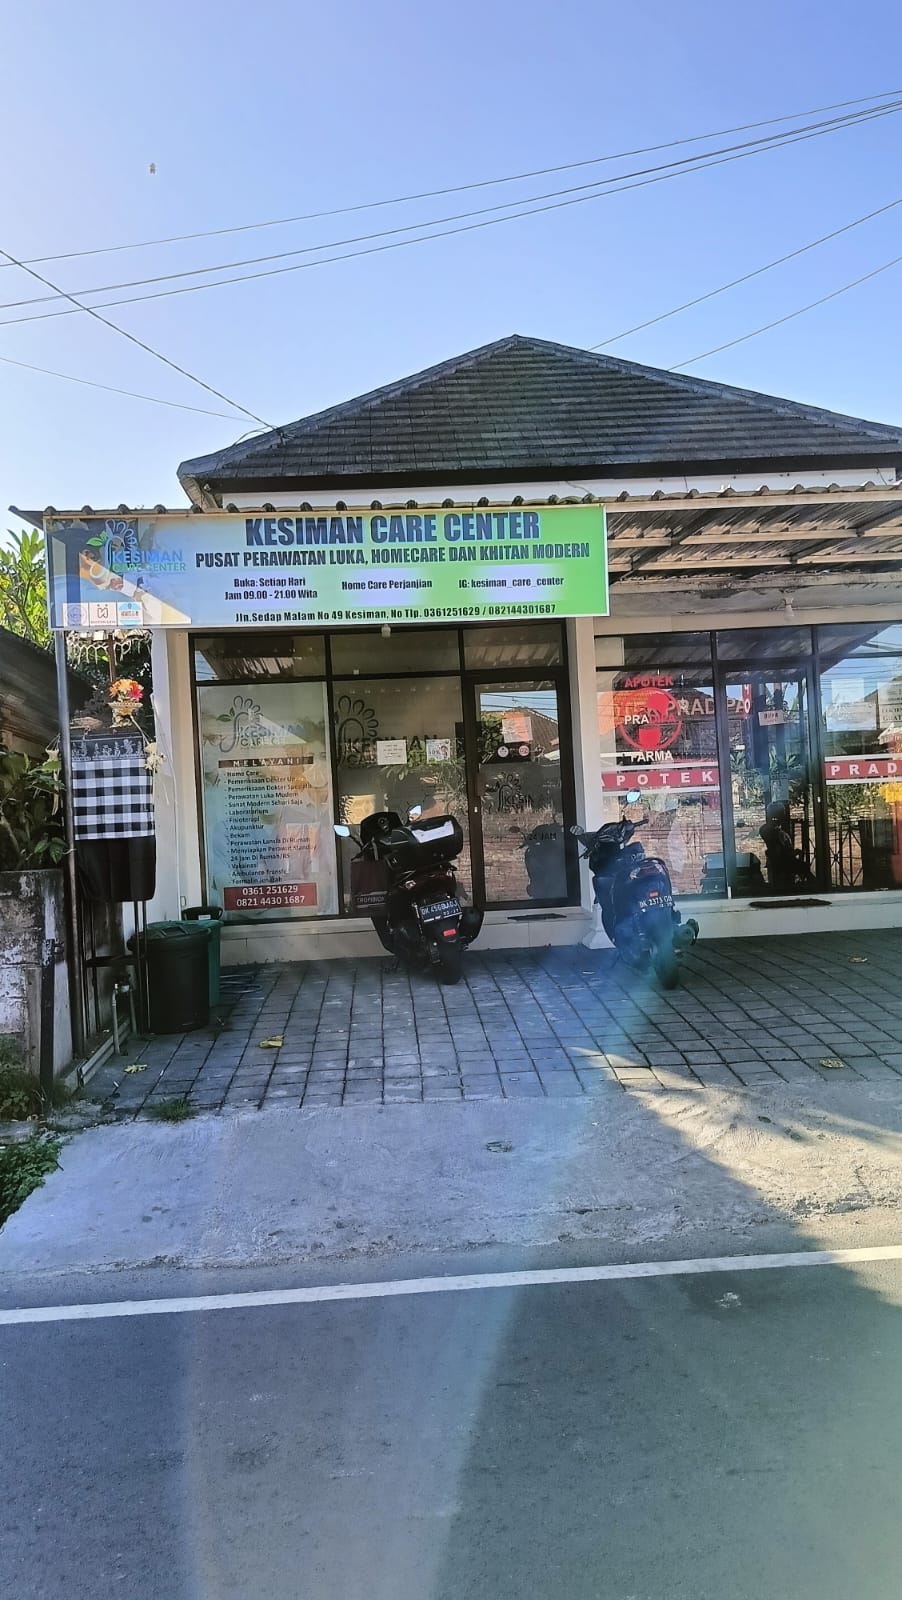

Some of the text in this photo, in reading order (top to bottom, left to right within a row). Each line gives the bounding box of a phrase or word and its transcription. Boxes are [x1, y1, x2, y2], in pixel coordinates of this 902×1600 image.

[245, 512, 540, 546] KESIMAN CARE CENTER
[112, 550, 183, 563] KESIMAN
[195, 543, 590, 568] PUSAT PERAWATAN LUKA, HOMECARE DAN KHITAN MODERN
[112, 562, 187, 573] CARE CENTER
[234, 577, 306, 588] Buka: Setiap Hari
[342, 580, 433, 591] Home Care Perjanjian
[459, 577, 565, 589] IG: kesiman_care_center
[225, 591, 242, 600] Jam
[243, 591, 268, 600] 09.00
[274, 590, 297, 599] 21.00
[298, 589, 318, 599] Wita
[284, 611, 315, 621] Malam
[317, 611, 329, 620] No
[331, 611, 343, 620] 49
[345, 609, 389, 620] Kesiman,
[391, 609, 402, 619] No
[405, 609, 422, 619] Tlp.
[423, 606, 480, 617] 0361251629
[488, 604, 556, 615] 082144301687
[624, 675, 675, 688] APOTEK
[624, 713, 676, 725] PRADIPA
[233, 757, 300, 767] MELAYANI
[630, 750, 674, 763] FARMA
[831, 762, 898, 776] PRAD
[242, 885, 298, 896] 0361 251629
[236, 895, 305, 907] 0821 4430 1687
